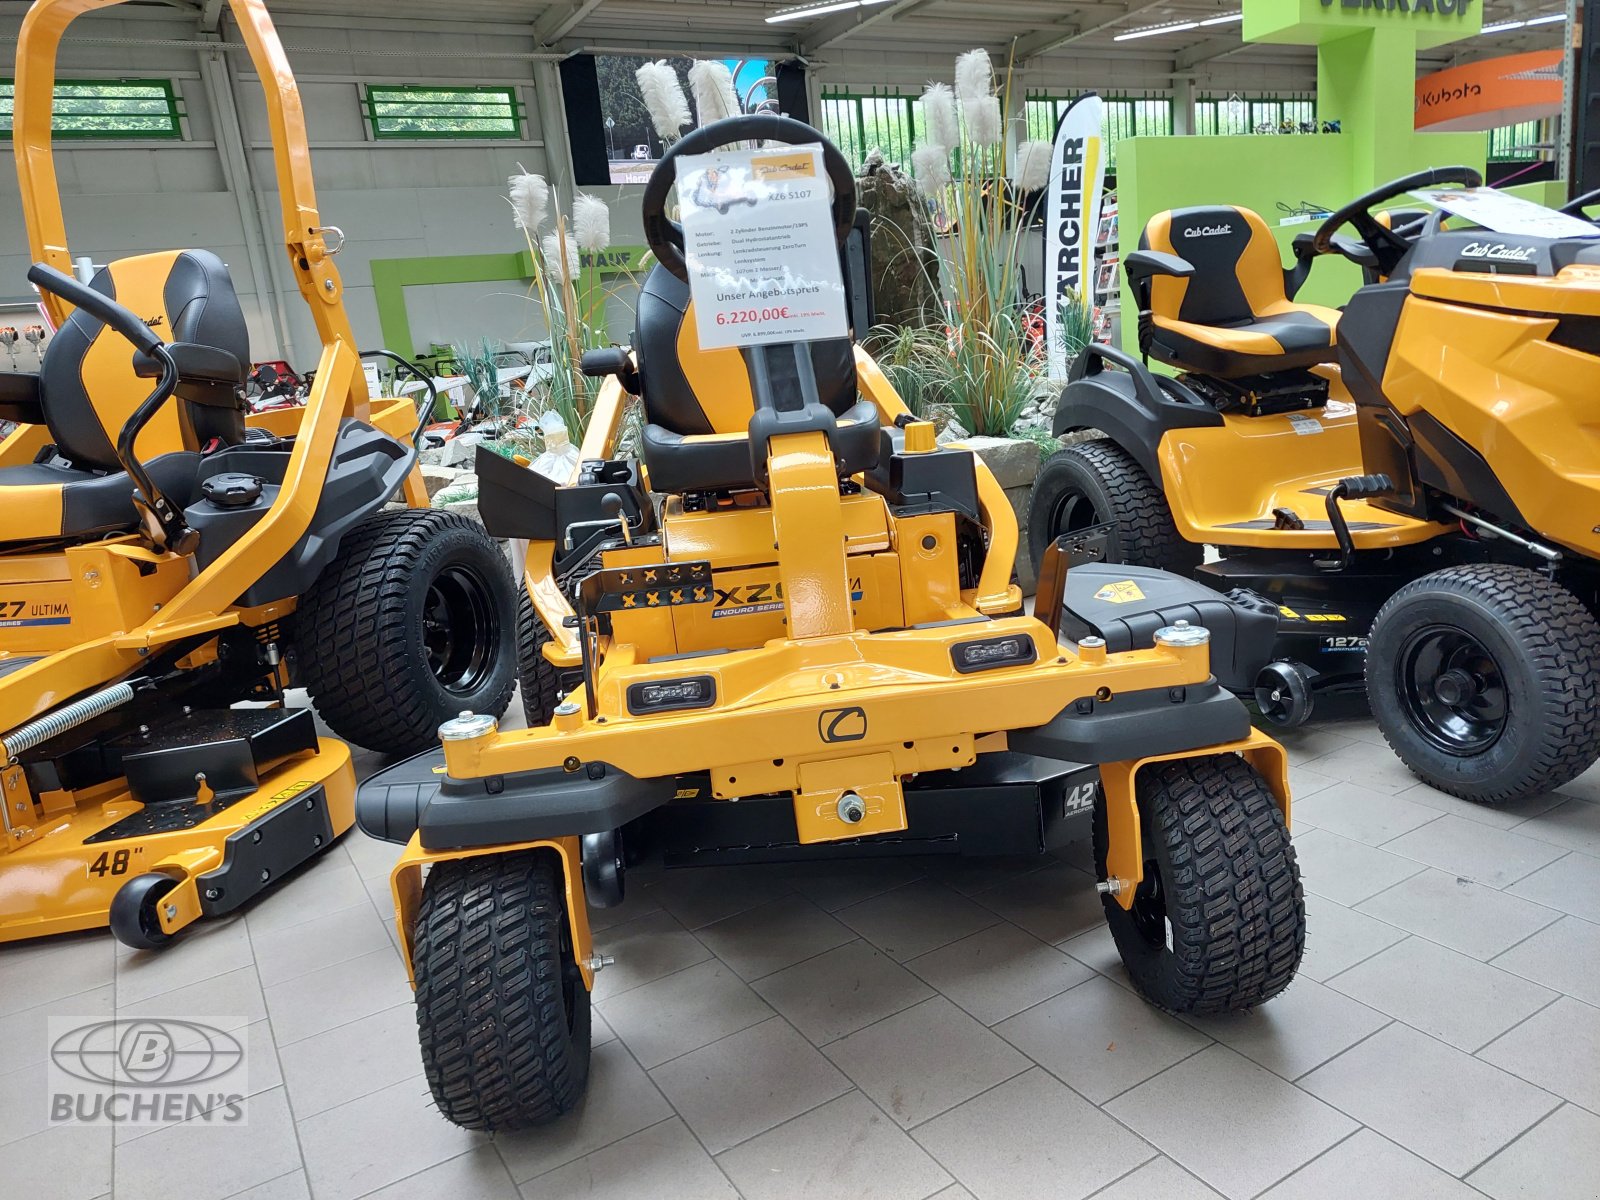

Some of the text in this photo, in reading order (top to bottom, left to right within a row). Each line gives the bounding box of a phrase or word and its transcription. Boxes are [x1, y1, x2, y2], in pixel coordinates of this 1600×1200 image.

[1422, 83, 1482, 106] Kubota
[788, 190, 812, 200] S107
[1184, 224, 1232, 238] Cub Cadet
[782, 242, 807, 250] ZeroTurn
[1461, 242, 1537, 261] Cub Cadet
[716, 285, 820, 302] Unser Angebotspreis
[716, 306, 789, 326] 6.220,00€
[31, 603, 70, 616] ULTIMA
[714, 602, 785, 617] ENDURO SERIE
